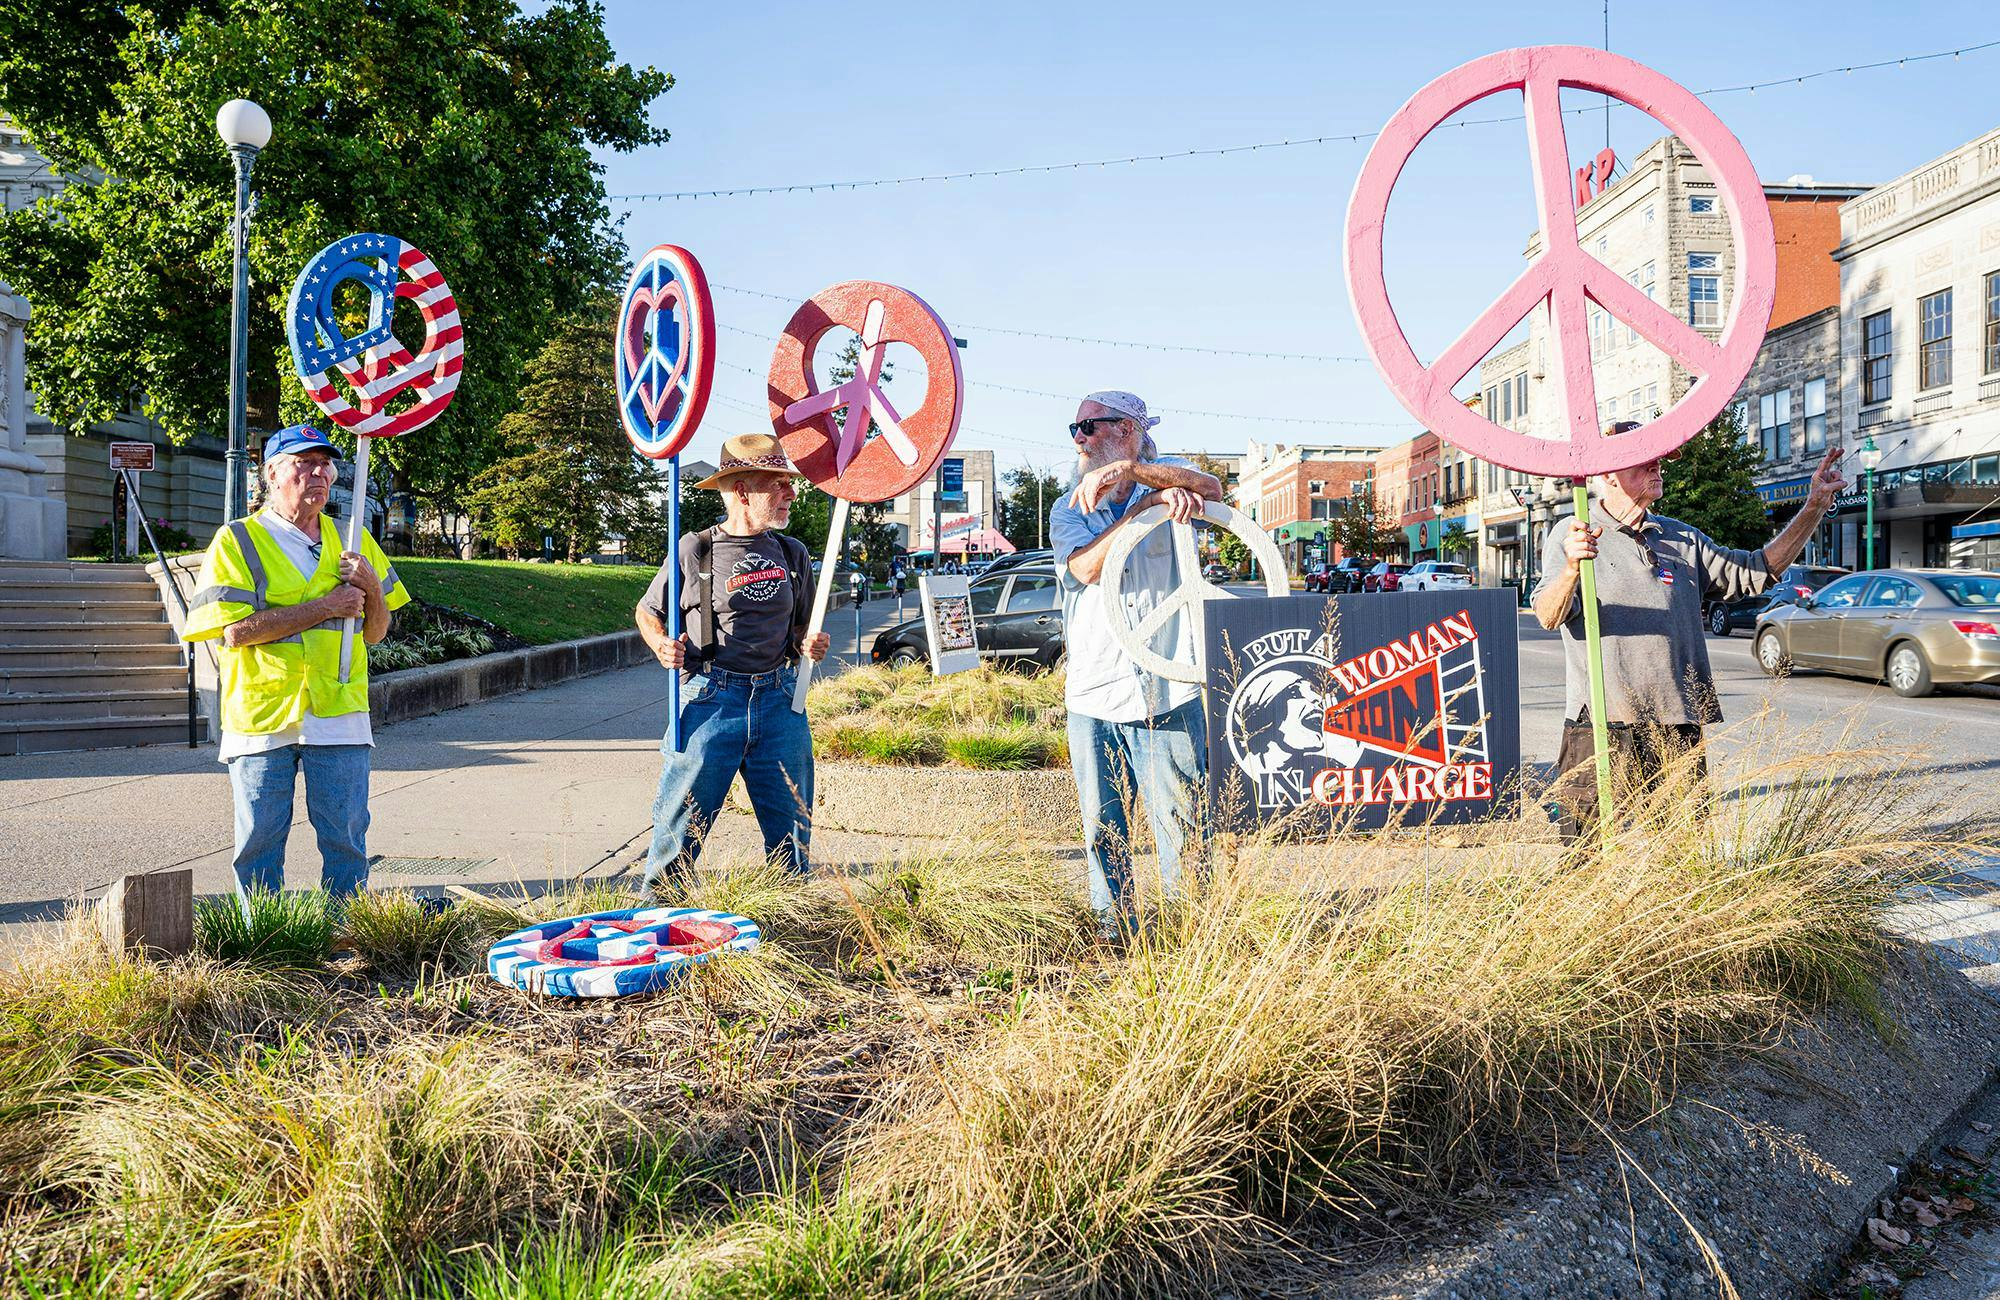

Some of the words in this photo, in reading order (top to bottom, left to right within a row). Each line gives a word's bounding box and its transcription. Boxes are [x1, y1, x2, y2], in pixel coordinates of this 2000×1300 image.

[1774, 483, 1811, 499] EMPTO
[732, 569, 781, 586] SUBCULTURE
[744, 580, 776, 596] CYCLERY
[1241, 628, 1312, 667] PUT
[1305, 632, 1335, 663] A
[1328, 609, 1478, 695] WOMAN
[1259, 769, 1304, 808] IN
[1311, 762, 1493, 806] CHARGE
